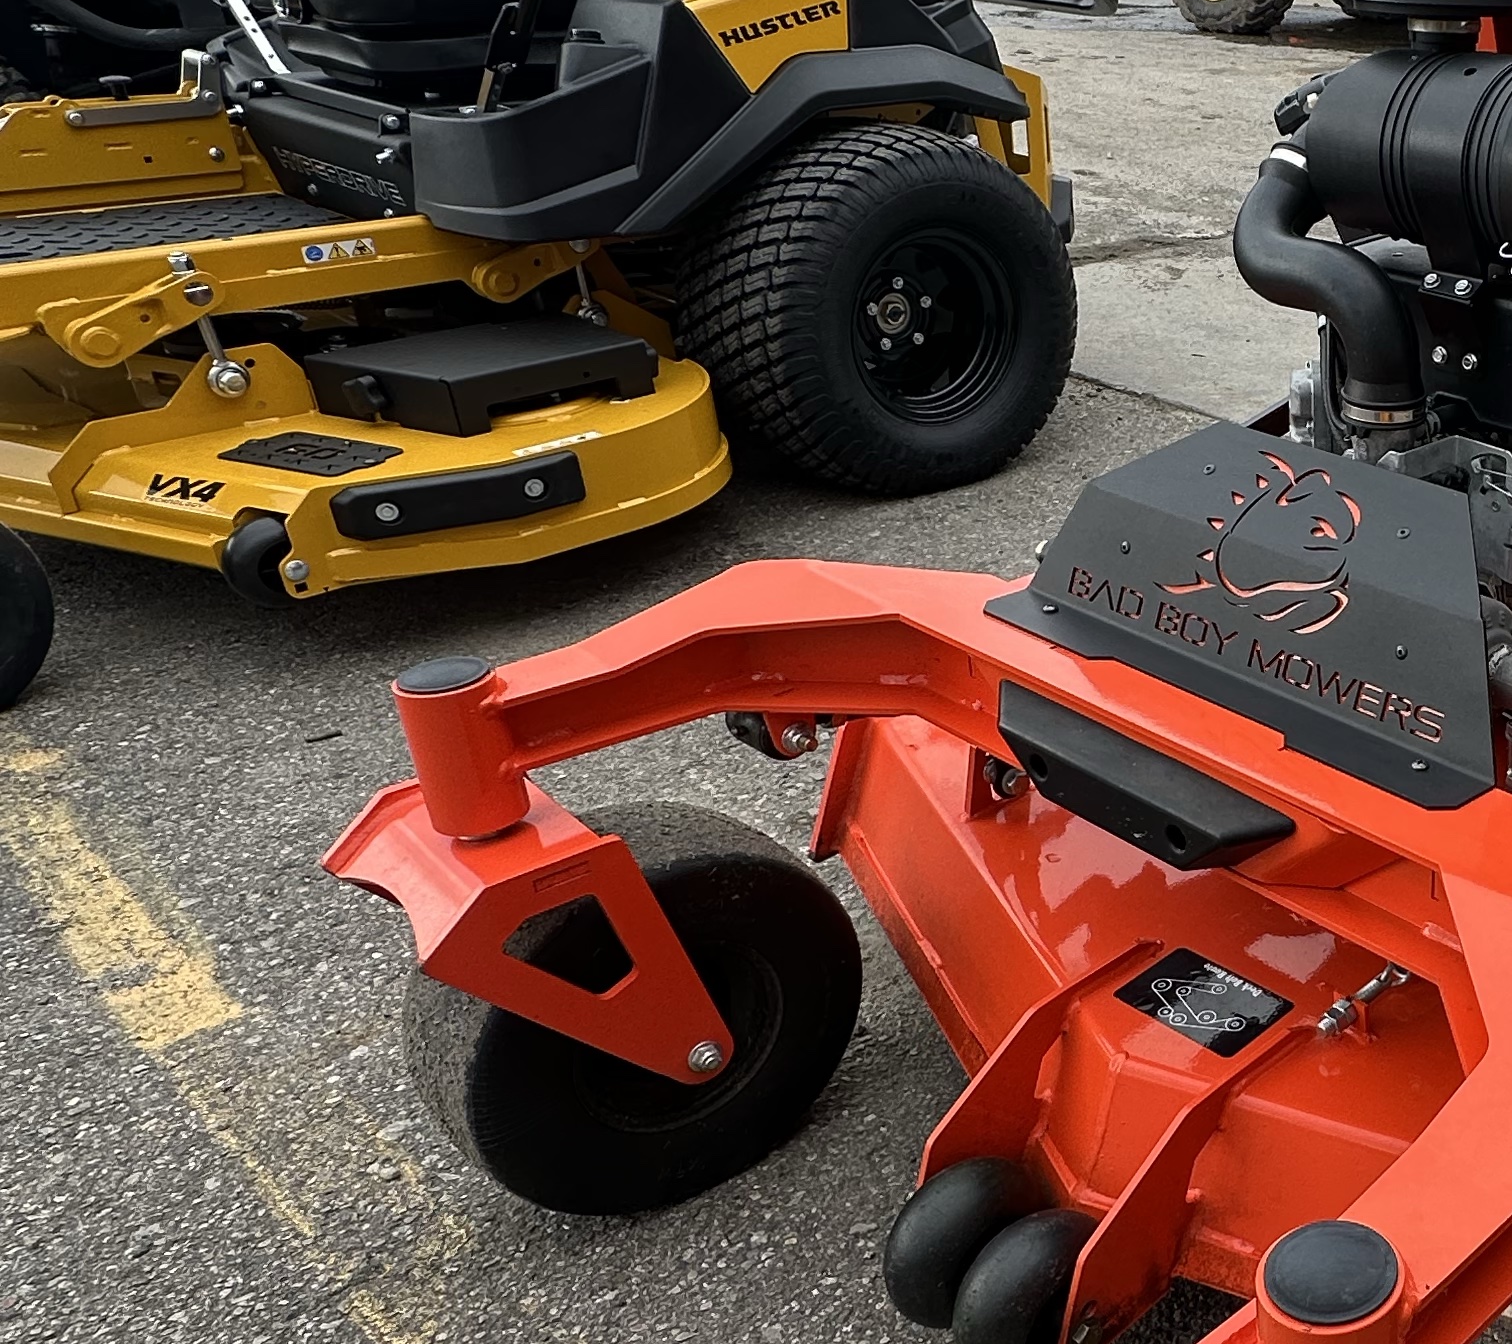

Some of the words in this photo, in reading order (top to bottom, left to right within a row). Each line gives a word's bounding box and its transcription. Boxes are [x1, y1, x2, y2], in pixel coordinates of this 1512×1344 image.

[718, 0, 842, 47] HUSTLER
[143, 495, 205, 508] TECHNOLOGY
[146, 473, 227, 503] VX4
[1067, 566, 1144, 620] BAD
[1154, 601, 1238, 655] BOY
[1247, 638, 1445, 743] MOWERS
